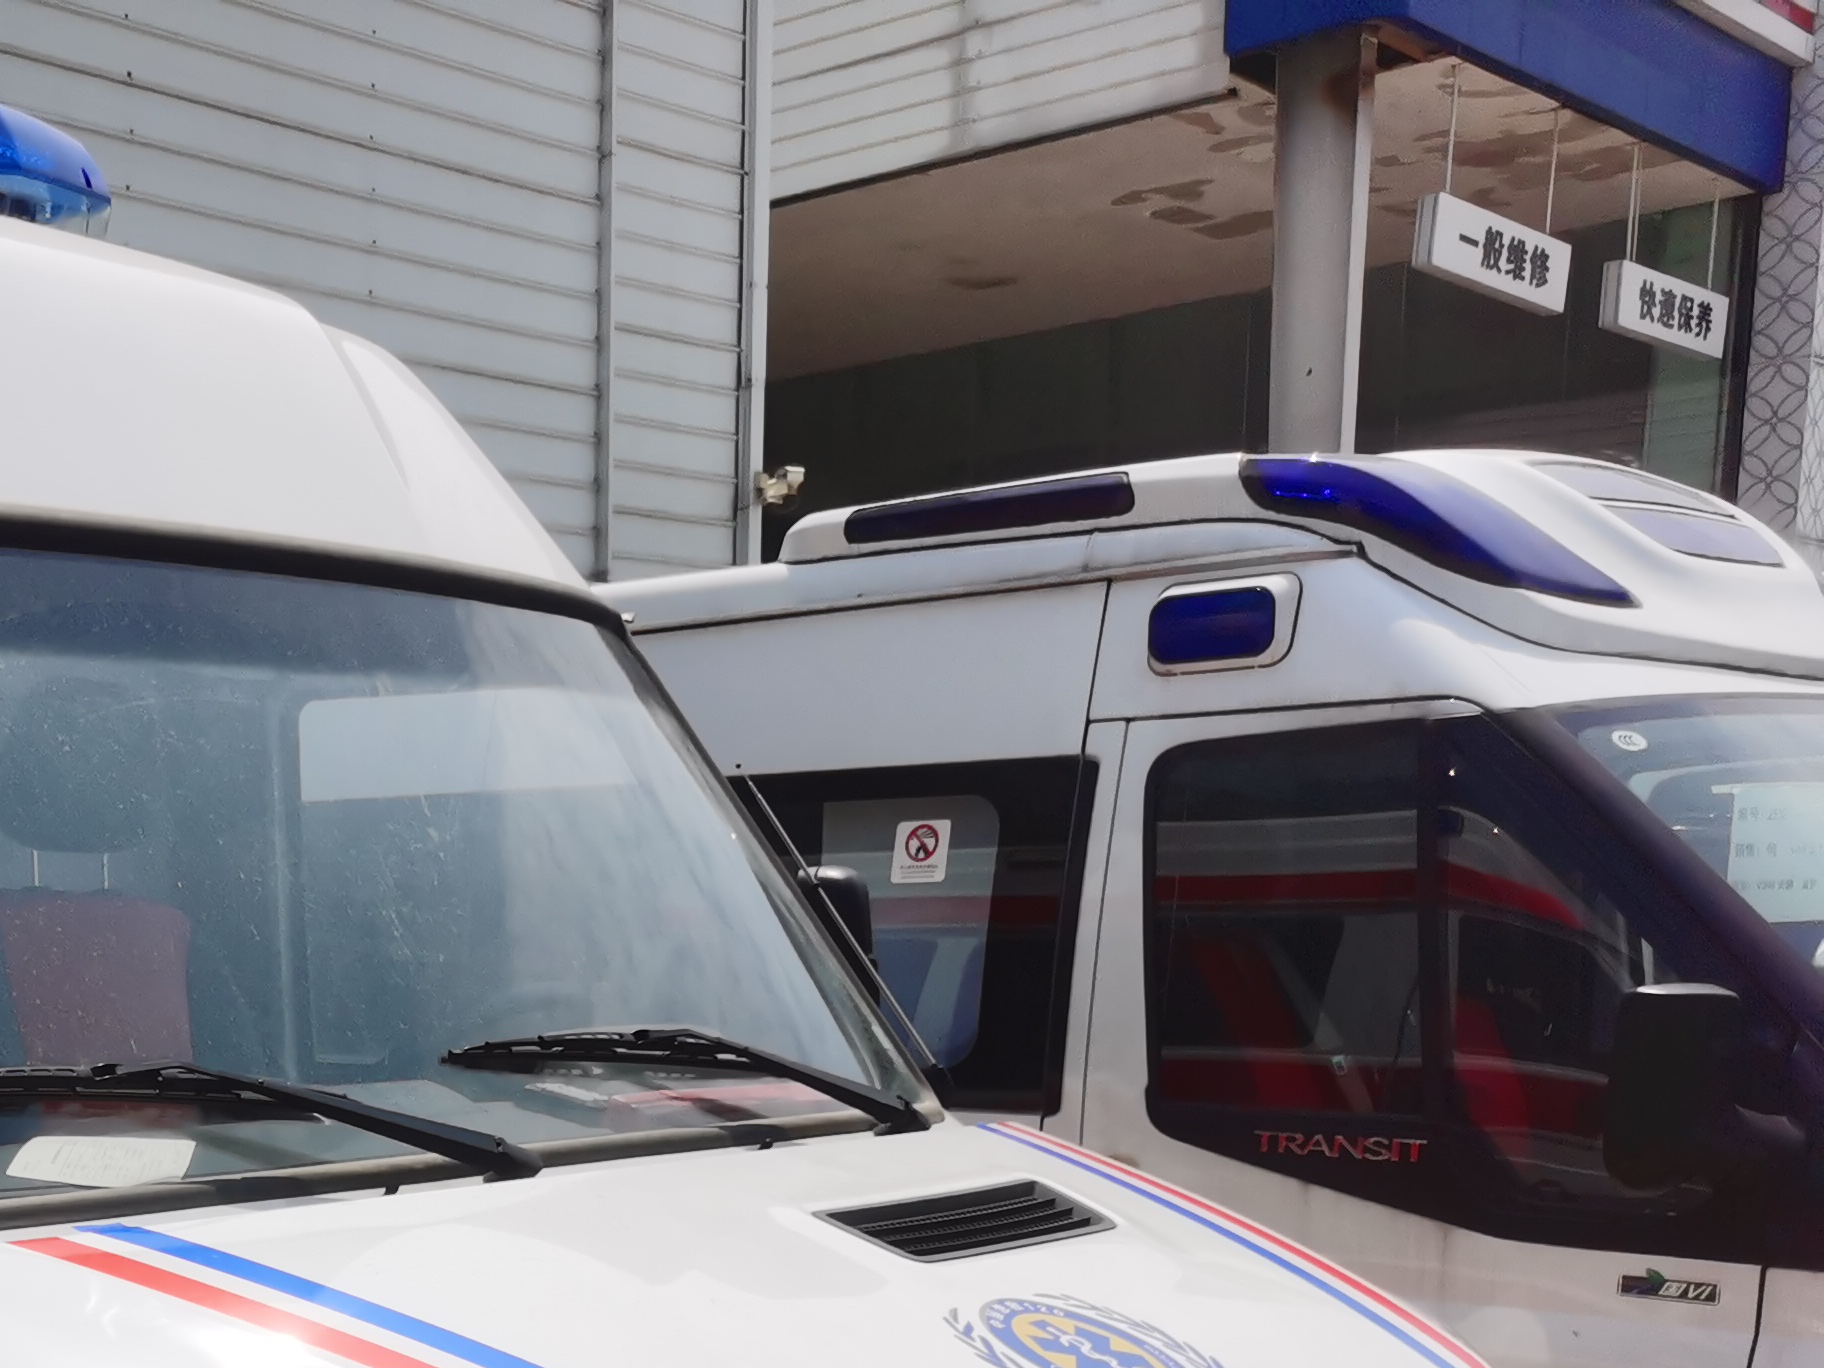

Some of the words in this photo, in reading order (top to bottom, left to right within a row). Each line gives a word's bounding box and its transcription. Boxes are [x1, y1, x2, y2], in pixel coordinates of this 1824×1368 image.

[1459, 225, 1550, 288] 一般维修
[1639, 279, 1713, 341] 快速保养
[1253, 1130, 1428, 1163] TRANSIT
